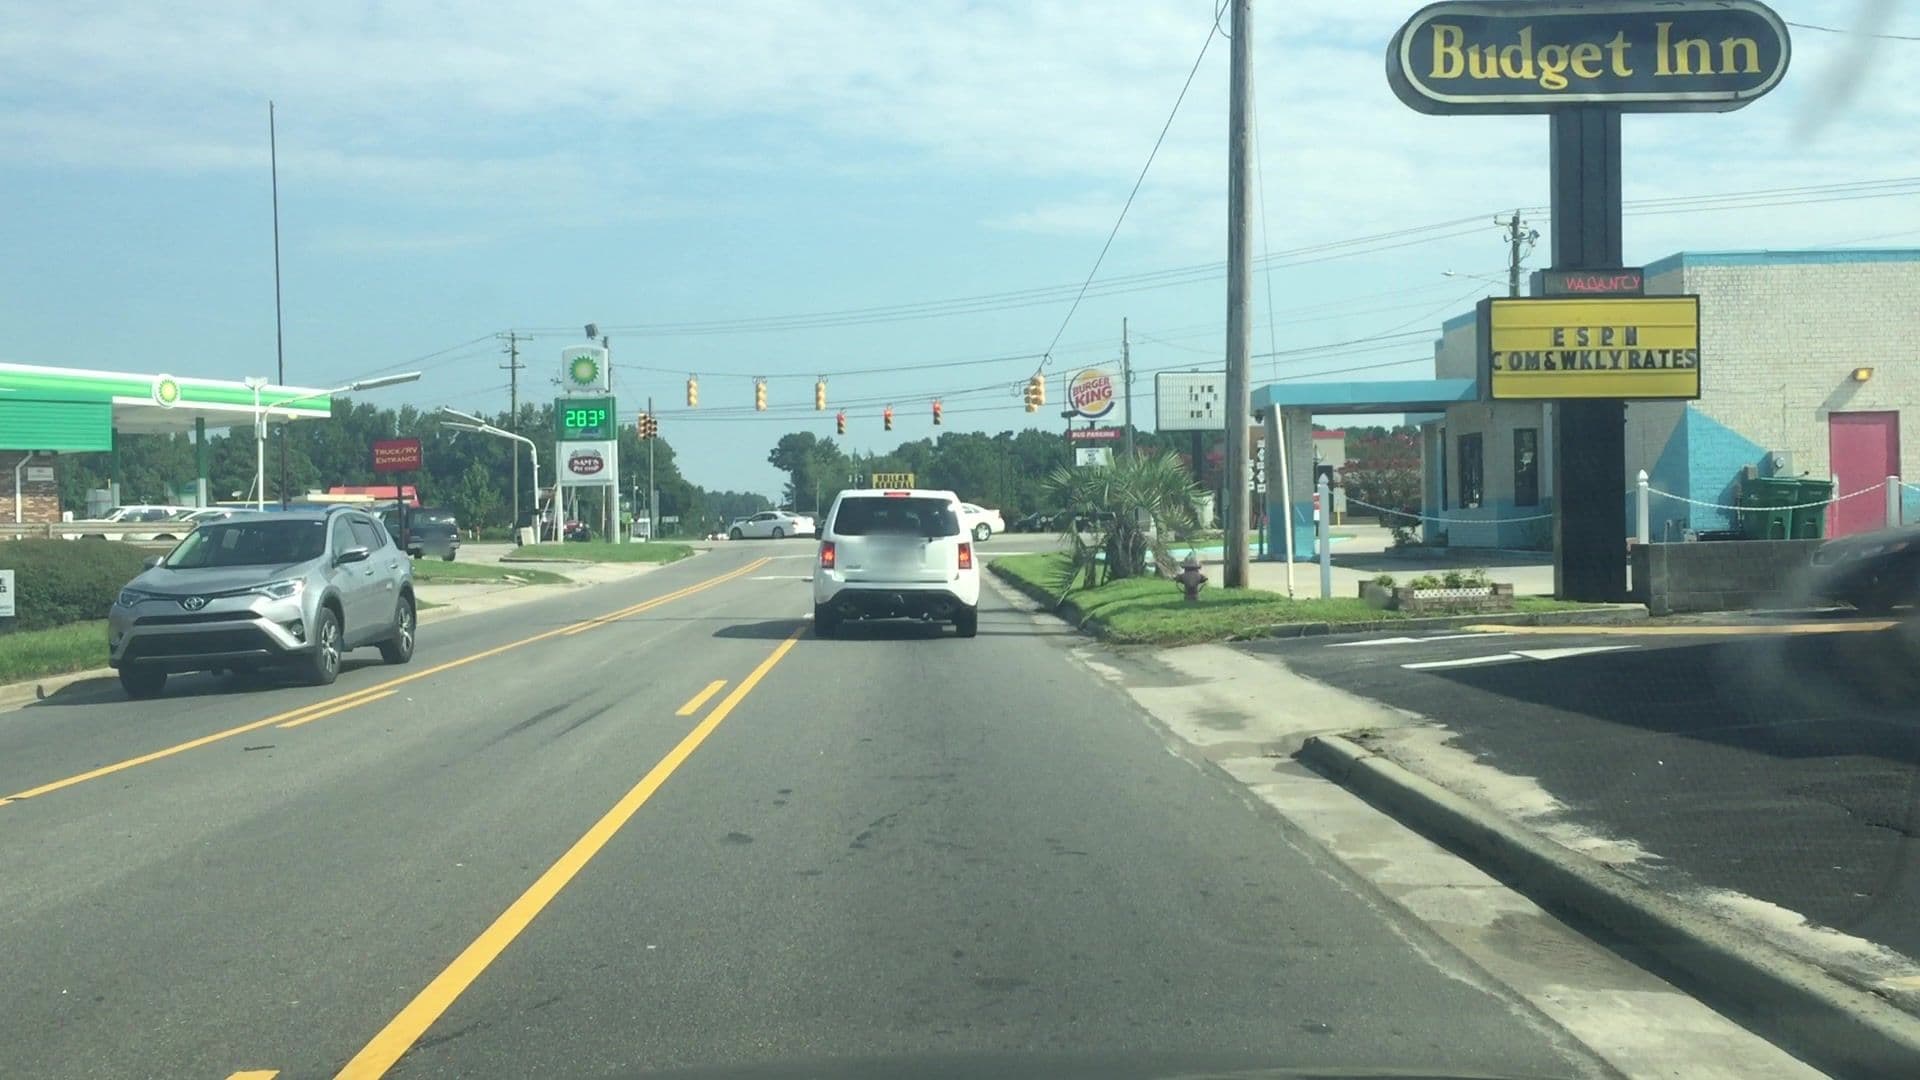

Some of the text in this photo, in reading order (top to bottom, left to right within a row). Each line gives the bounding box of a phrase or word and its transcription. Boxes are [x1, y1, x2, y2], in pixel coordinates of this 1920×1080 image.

[1429, 22, 1761, 90] Budget Inn
[1567, 276, 1640, 290] VACANCY
[1553, 326, 1637, 346] ESPN
[1073, 376, 1111, 398] BURGER
[1075, 386, 1113, 409] KING
[374, 446, 417, 456] TRUCK/RV
[375, 455, 417, 465] ENTRANCE
[877, 474, 909, 482] DOLLAR
